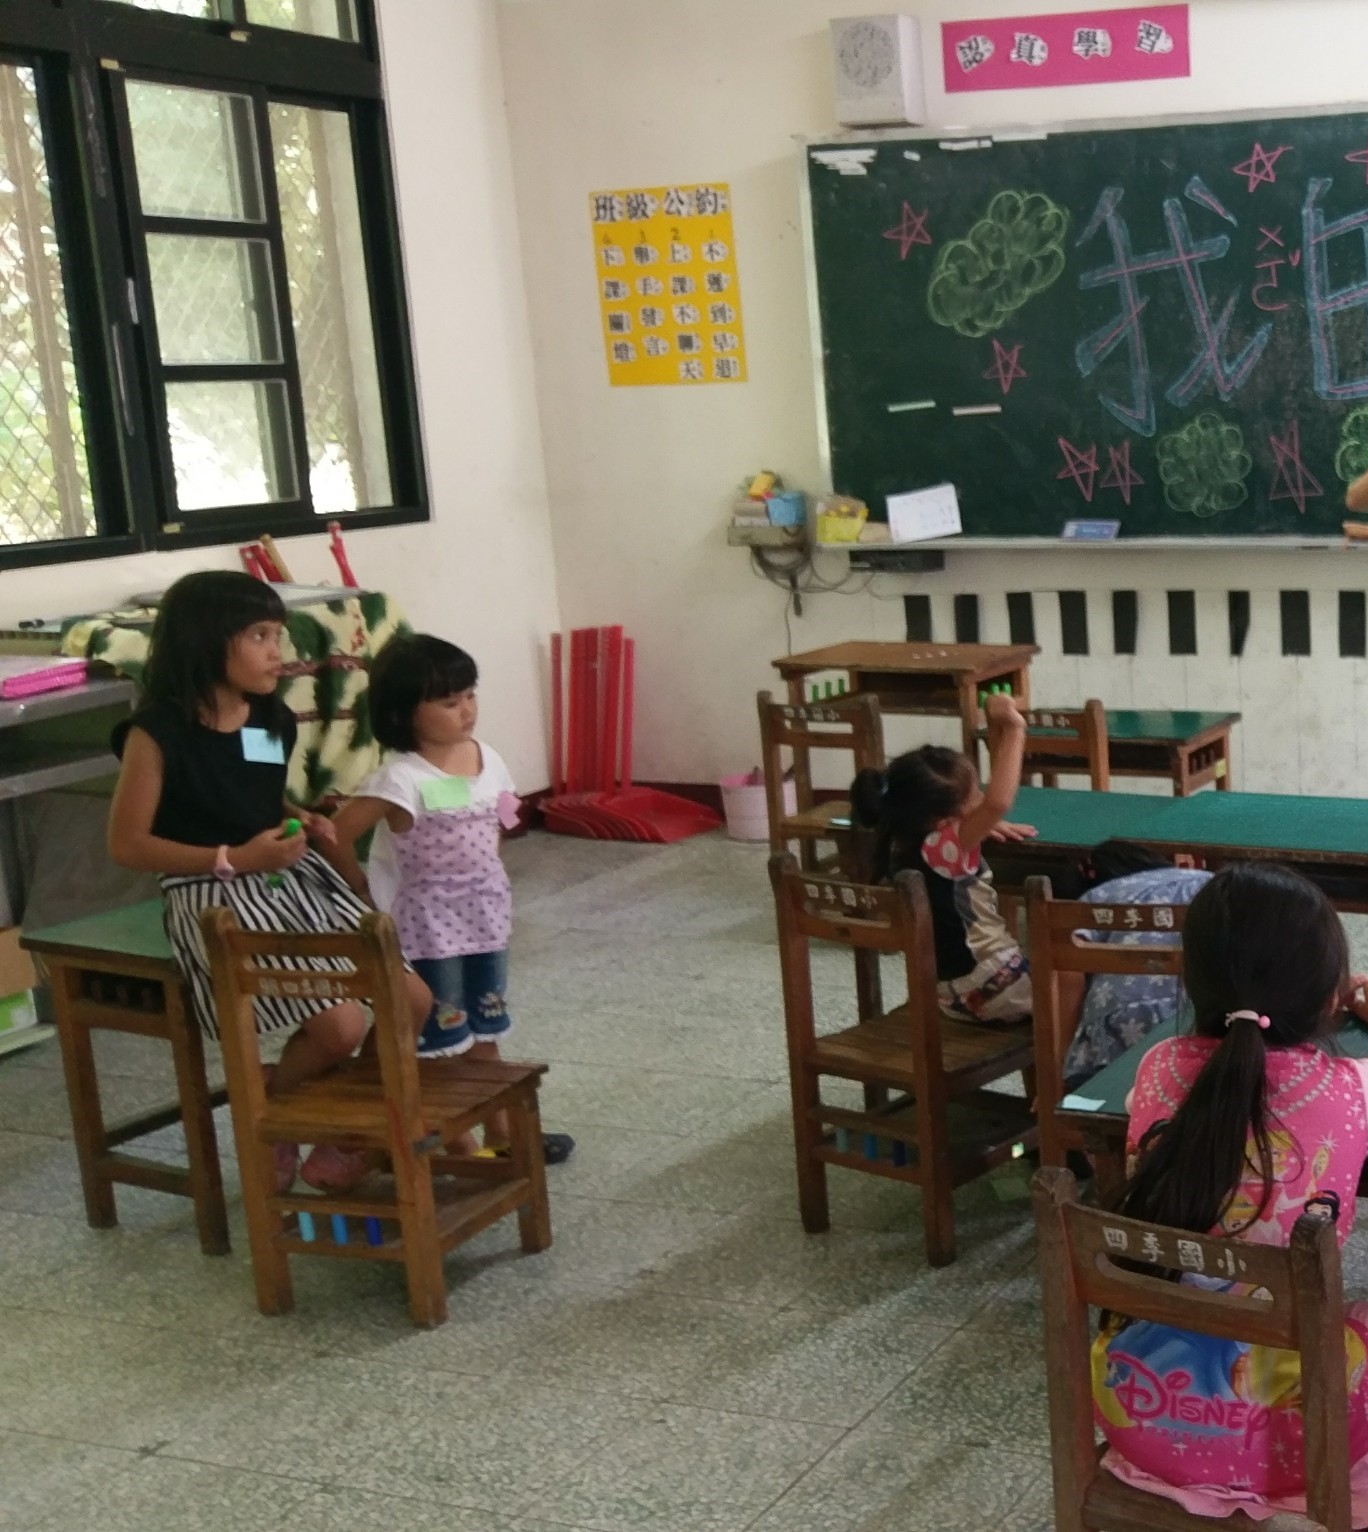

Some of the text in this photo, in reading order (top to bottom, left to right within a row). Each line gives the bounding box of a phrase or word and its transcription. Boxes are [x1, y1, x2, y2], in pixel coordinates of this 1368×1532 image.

[594, 188, 722, 221] 班級公約
[1102, 1226, 1247, 1276] 四季國小
